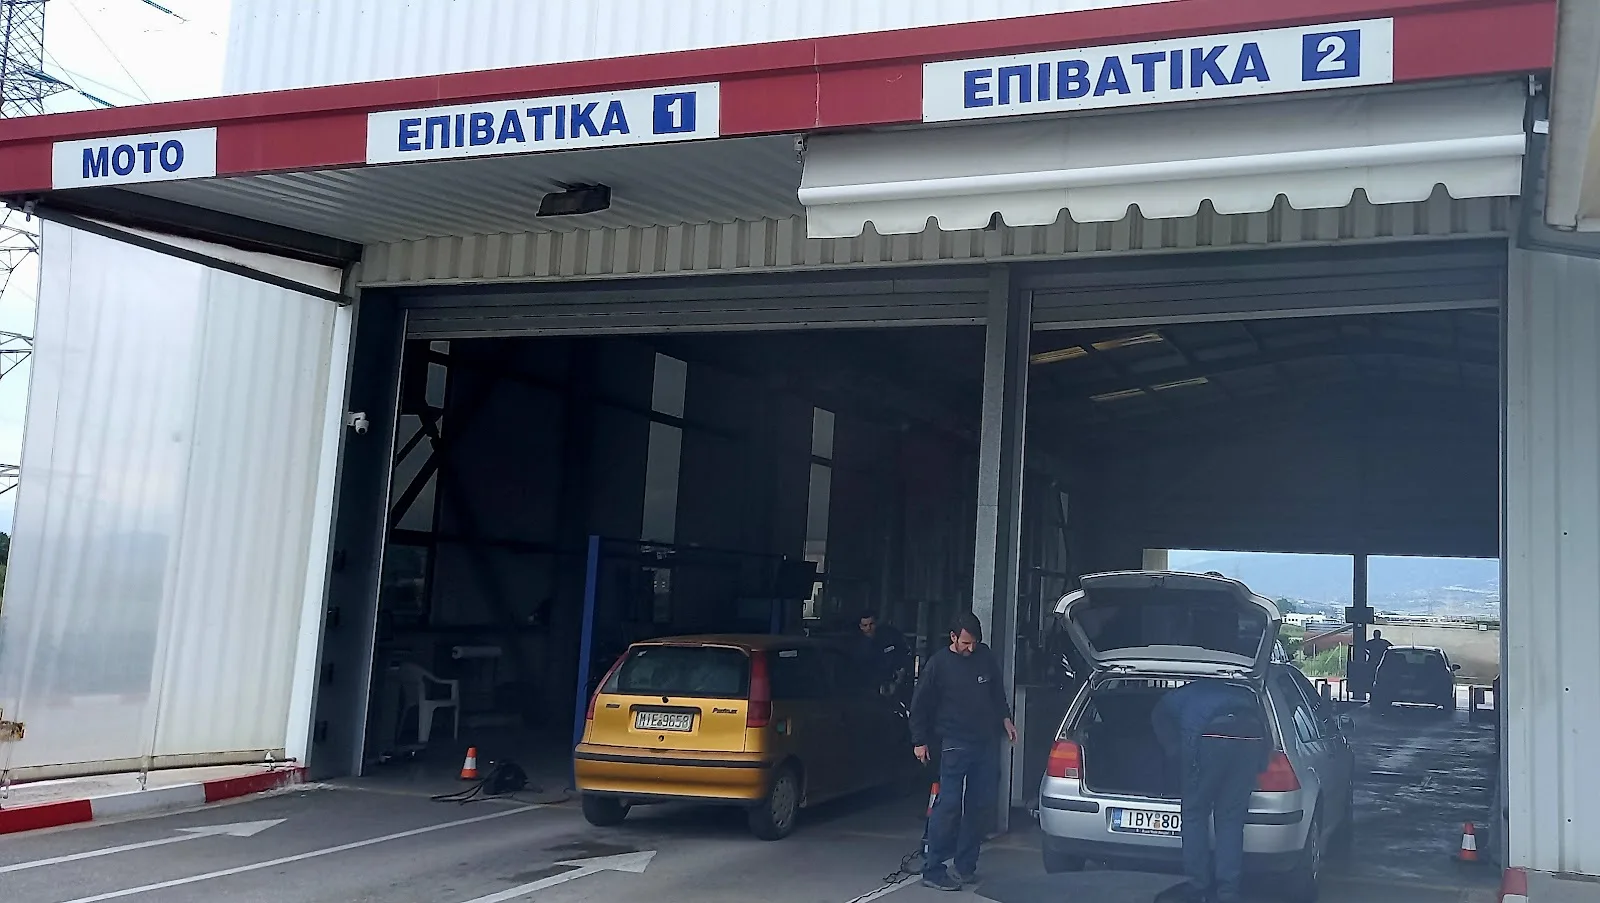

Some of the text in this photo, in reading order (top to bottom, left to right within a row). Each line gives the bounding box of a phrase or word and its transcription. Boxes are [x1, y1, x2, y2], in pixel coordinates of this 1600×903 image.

[963, 36, 1347, 108] ΕΠΙΒΑΤΙΚΑ 2
[399, 98, 682, 152] ΕΠΙΒΑΤΙΚΑ 1
